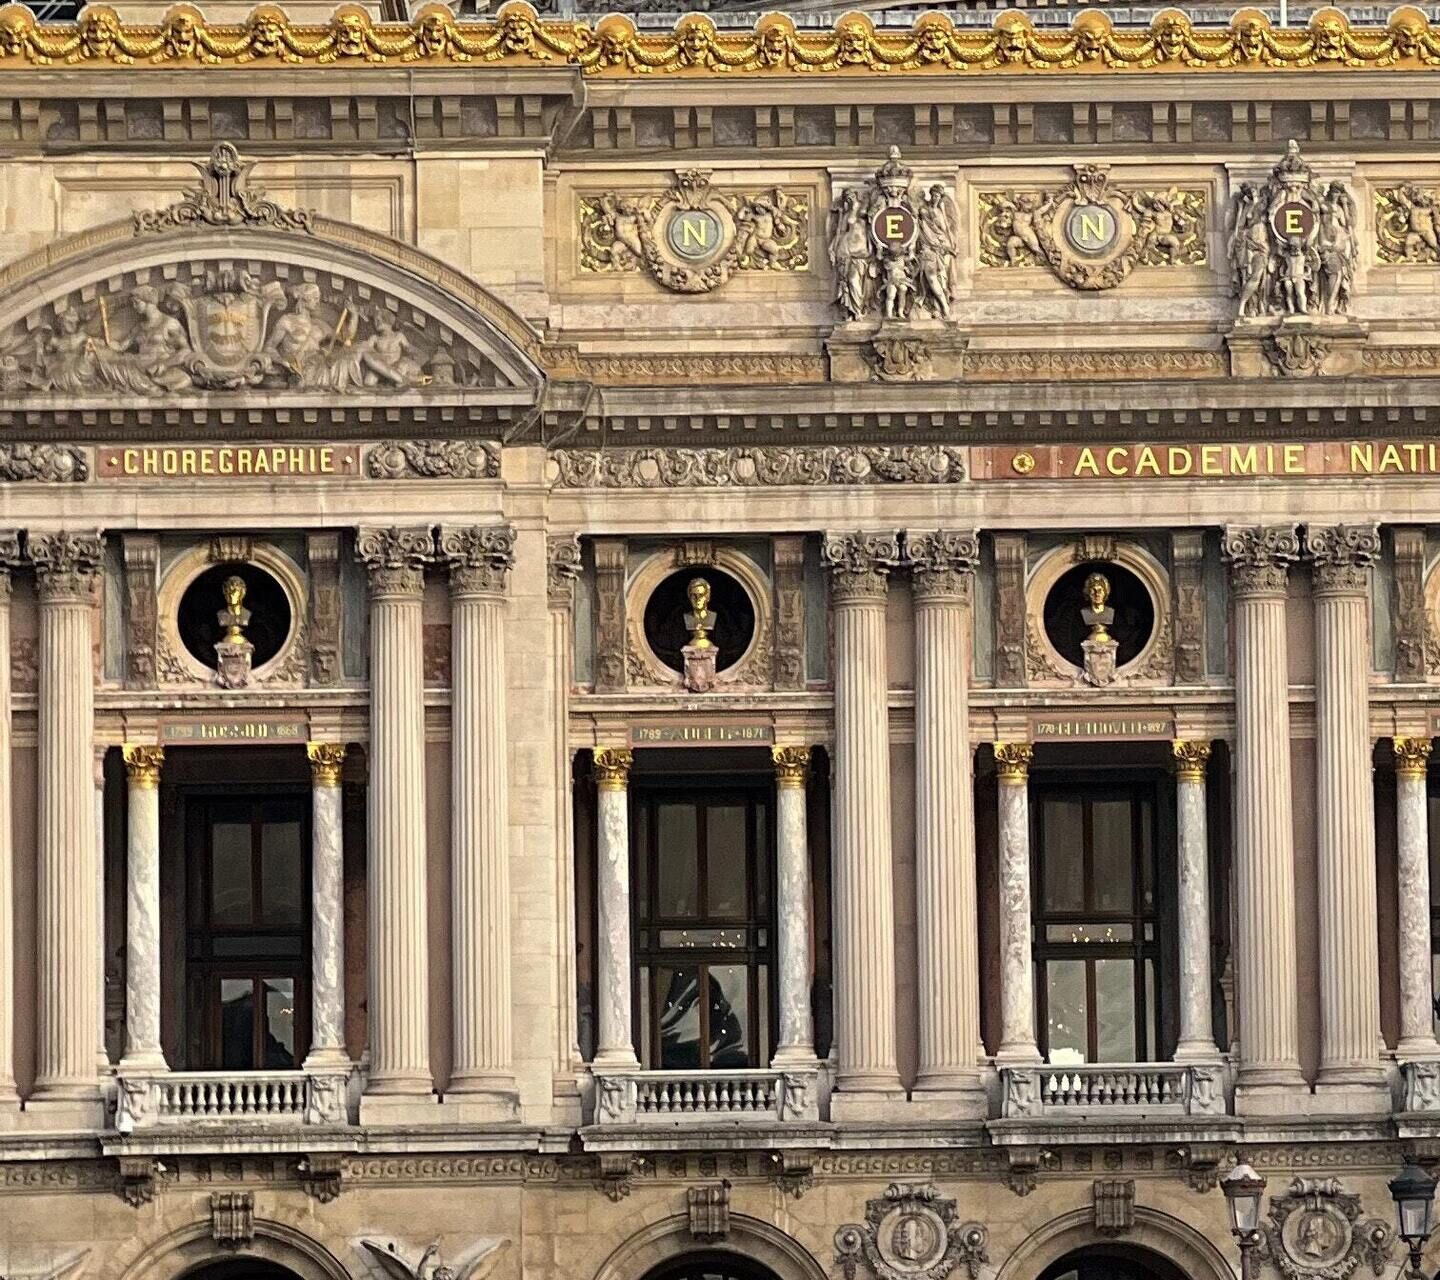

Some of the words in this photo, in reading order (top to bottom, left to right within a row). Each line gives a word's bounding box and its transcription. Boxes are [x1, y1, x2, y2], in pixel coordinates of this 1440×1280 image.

[682, 217, 707, 247] N
[885, 215, 903, 239] E
[1081, 214, 1105, 241] N
[1286, 210, 1303, 234] E
[124, 448, 335, 474] CHOREGRAPHIE
[1073, 445, 1306, 476] ACADEMIE
